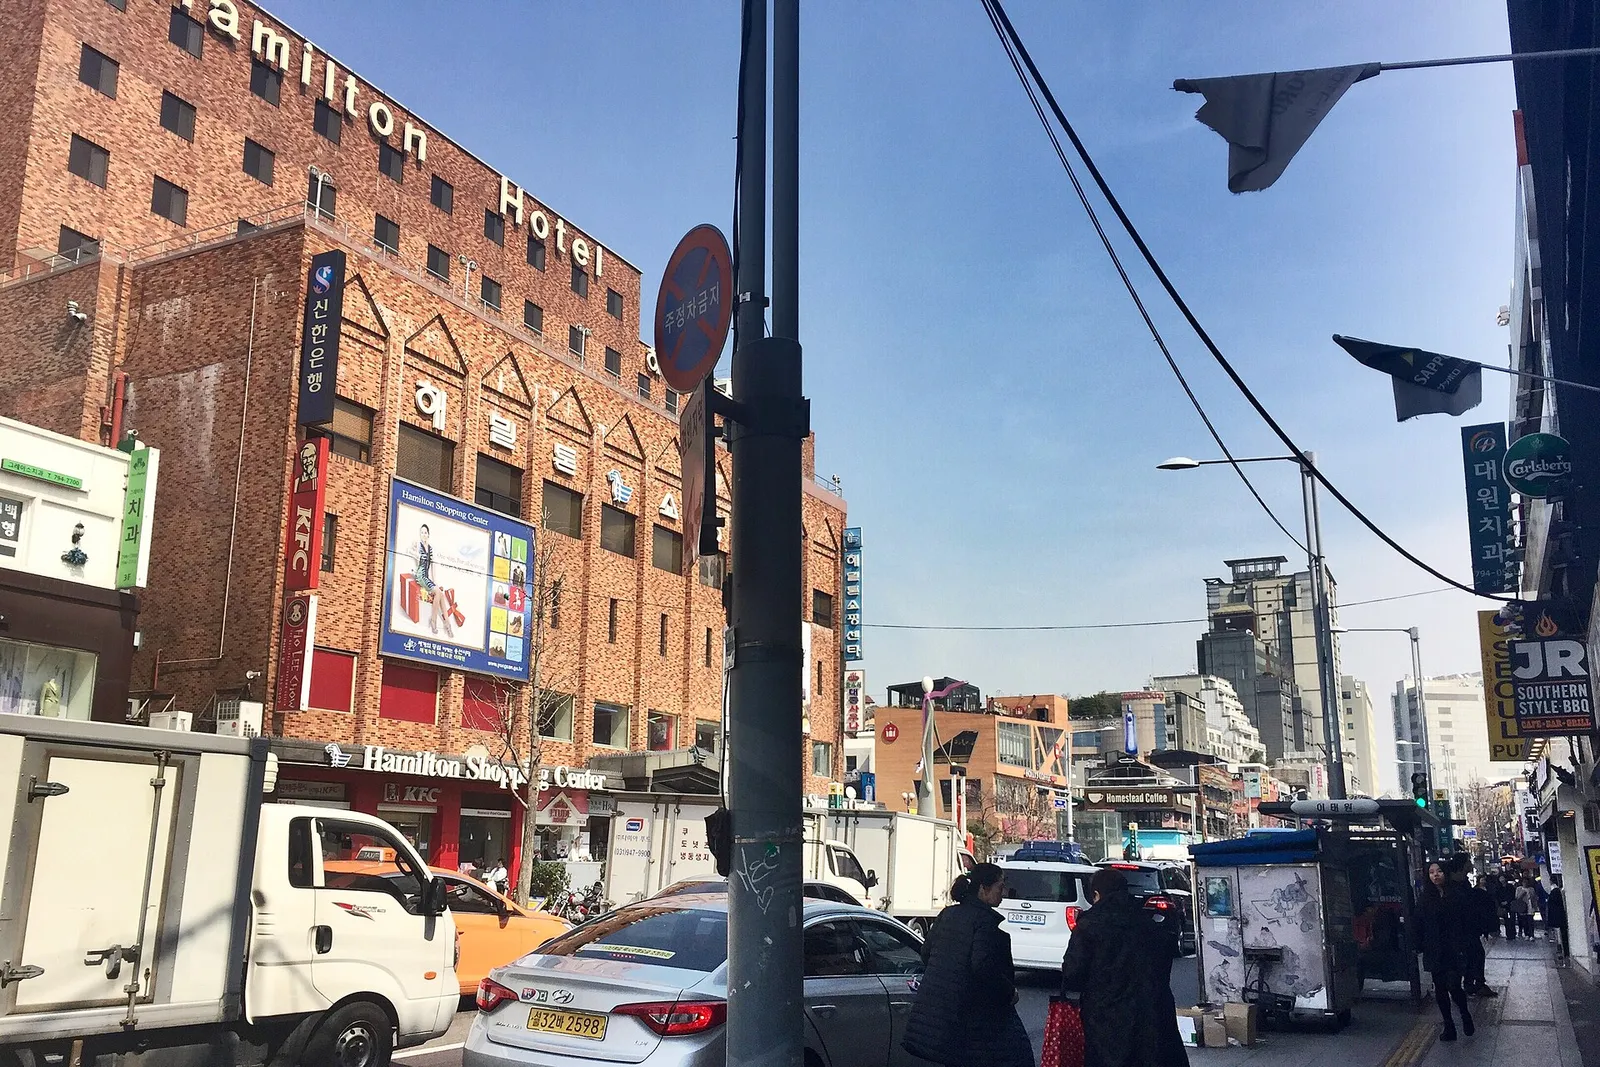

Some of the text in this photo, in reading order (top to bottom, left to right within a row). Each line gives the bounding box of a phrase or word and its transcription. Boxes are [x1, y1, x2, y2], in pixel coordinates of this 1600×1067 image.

[181, 0, 603, 277] amilton Hotel
[664, 281, 720, 334] 주정차금지
[306, 298, 328, 393] 신한은행
[1414, 355, 1451, 385] SAPP
[1509, 455, 1571, 479] Carlsberg
[124, 498, 141, 544] 치과
[402, 489, 490, 526] Hamilton Shopping Center
[1473, 460, 1504, 563] 대원치과
[292, 505, 312, 570] KFC
[288, 628, 304, 708] HO LEE CHOW
[1513, 640, 1589, 679] JR
[1518, 684, 1588, 700] SOUTHERN
[362, 745, 607, 792] Hamilton Shoppig Center
[1492, 743, 1524, 758] PU
[403, 785, 442, 803] KFC
[1106, 793, 1168, 803] Homestead Coffee
[1316, 802, 1353, 813] 이태원
[566, 1015, 600, 1035] 2598
